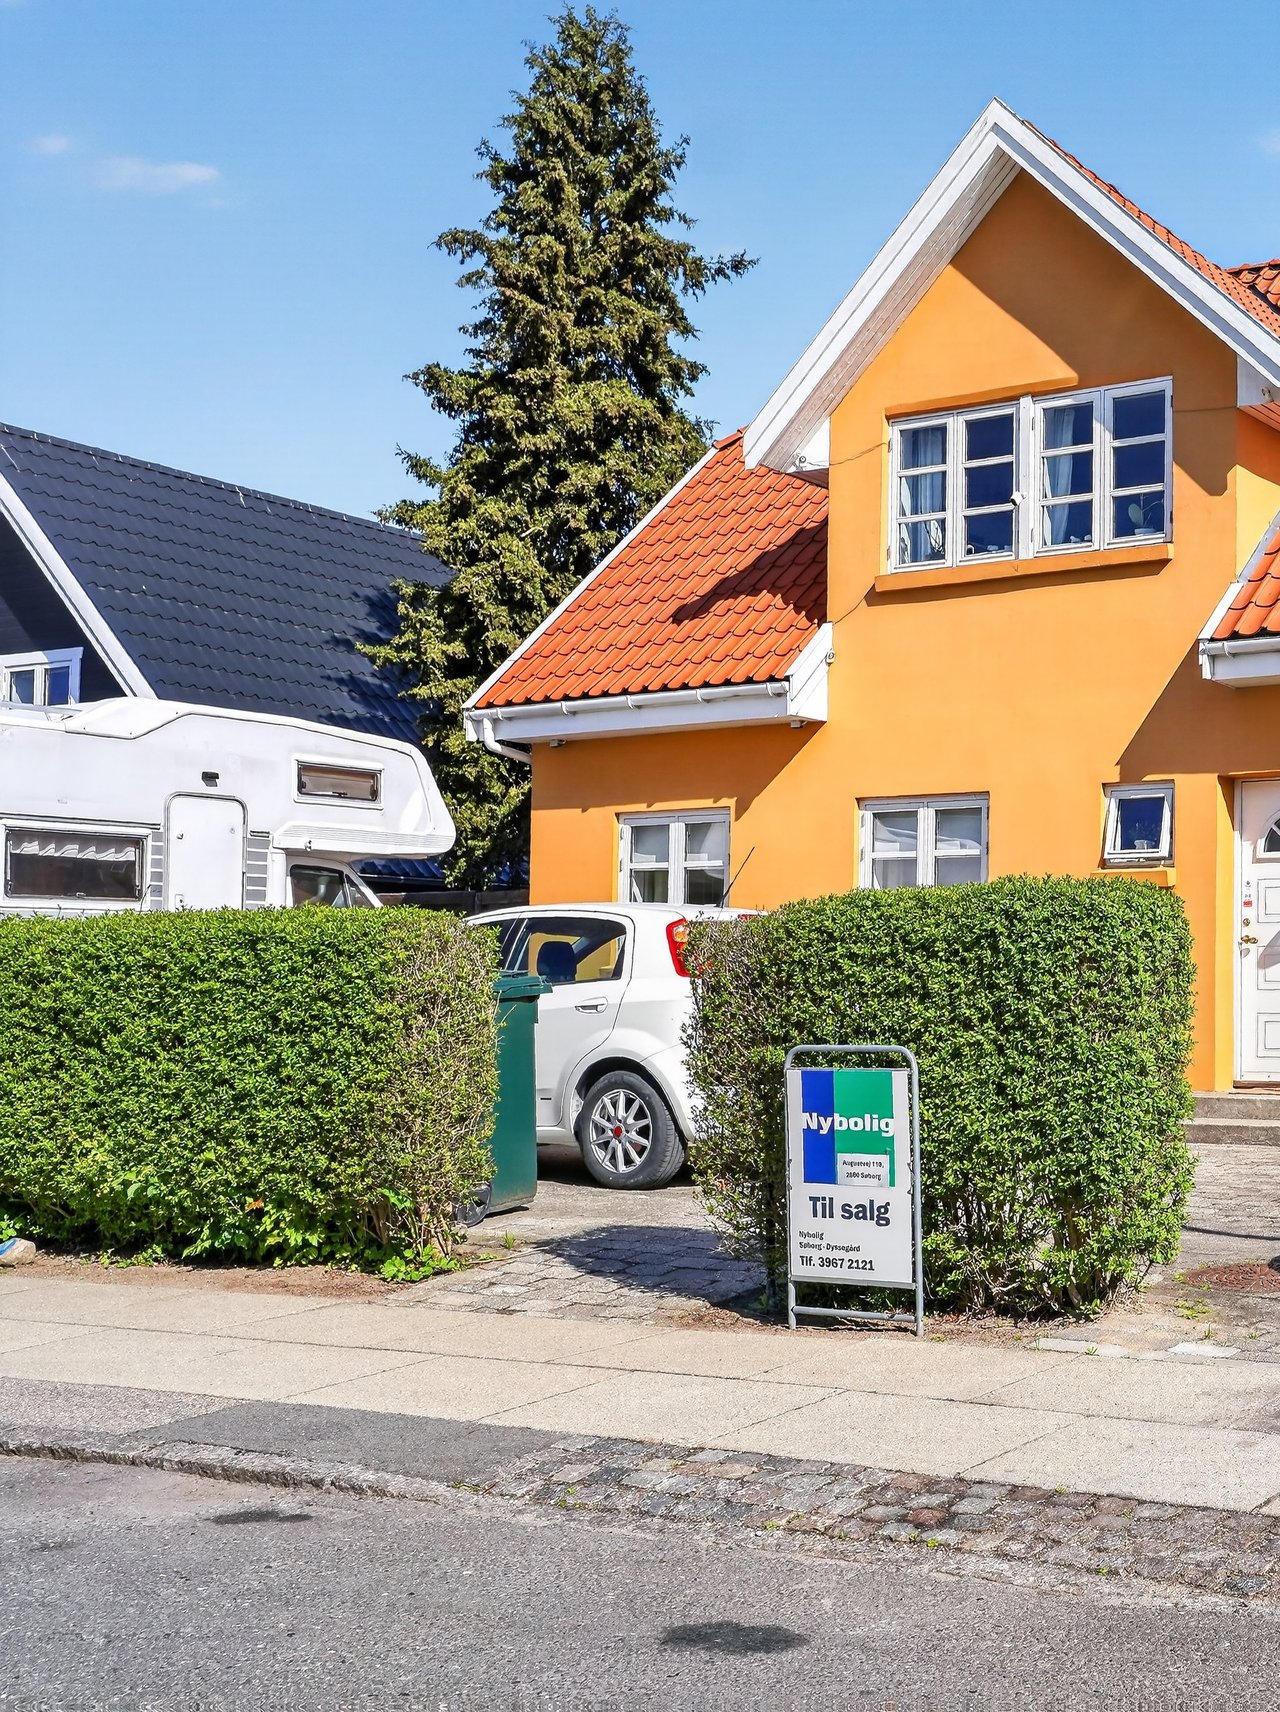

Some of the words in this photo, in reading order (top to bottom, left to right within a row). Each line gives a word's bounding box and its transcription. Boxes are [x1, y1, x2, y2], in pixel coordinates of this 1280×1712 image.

[801, 1112, 896, 1137] Nybolig
[808, 1196, 835, 1219] Til
[841, 1199, 891, 1227] salg
[799, 1230, 824, 1240] Nybolig
[800, 1255, 816, 1267] Tlf.
[818, 1256, 845, 1269] 3967
[847, 1258, 875, 1271] 2121
